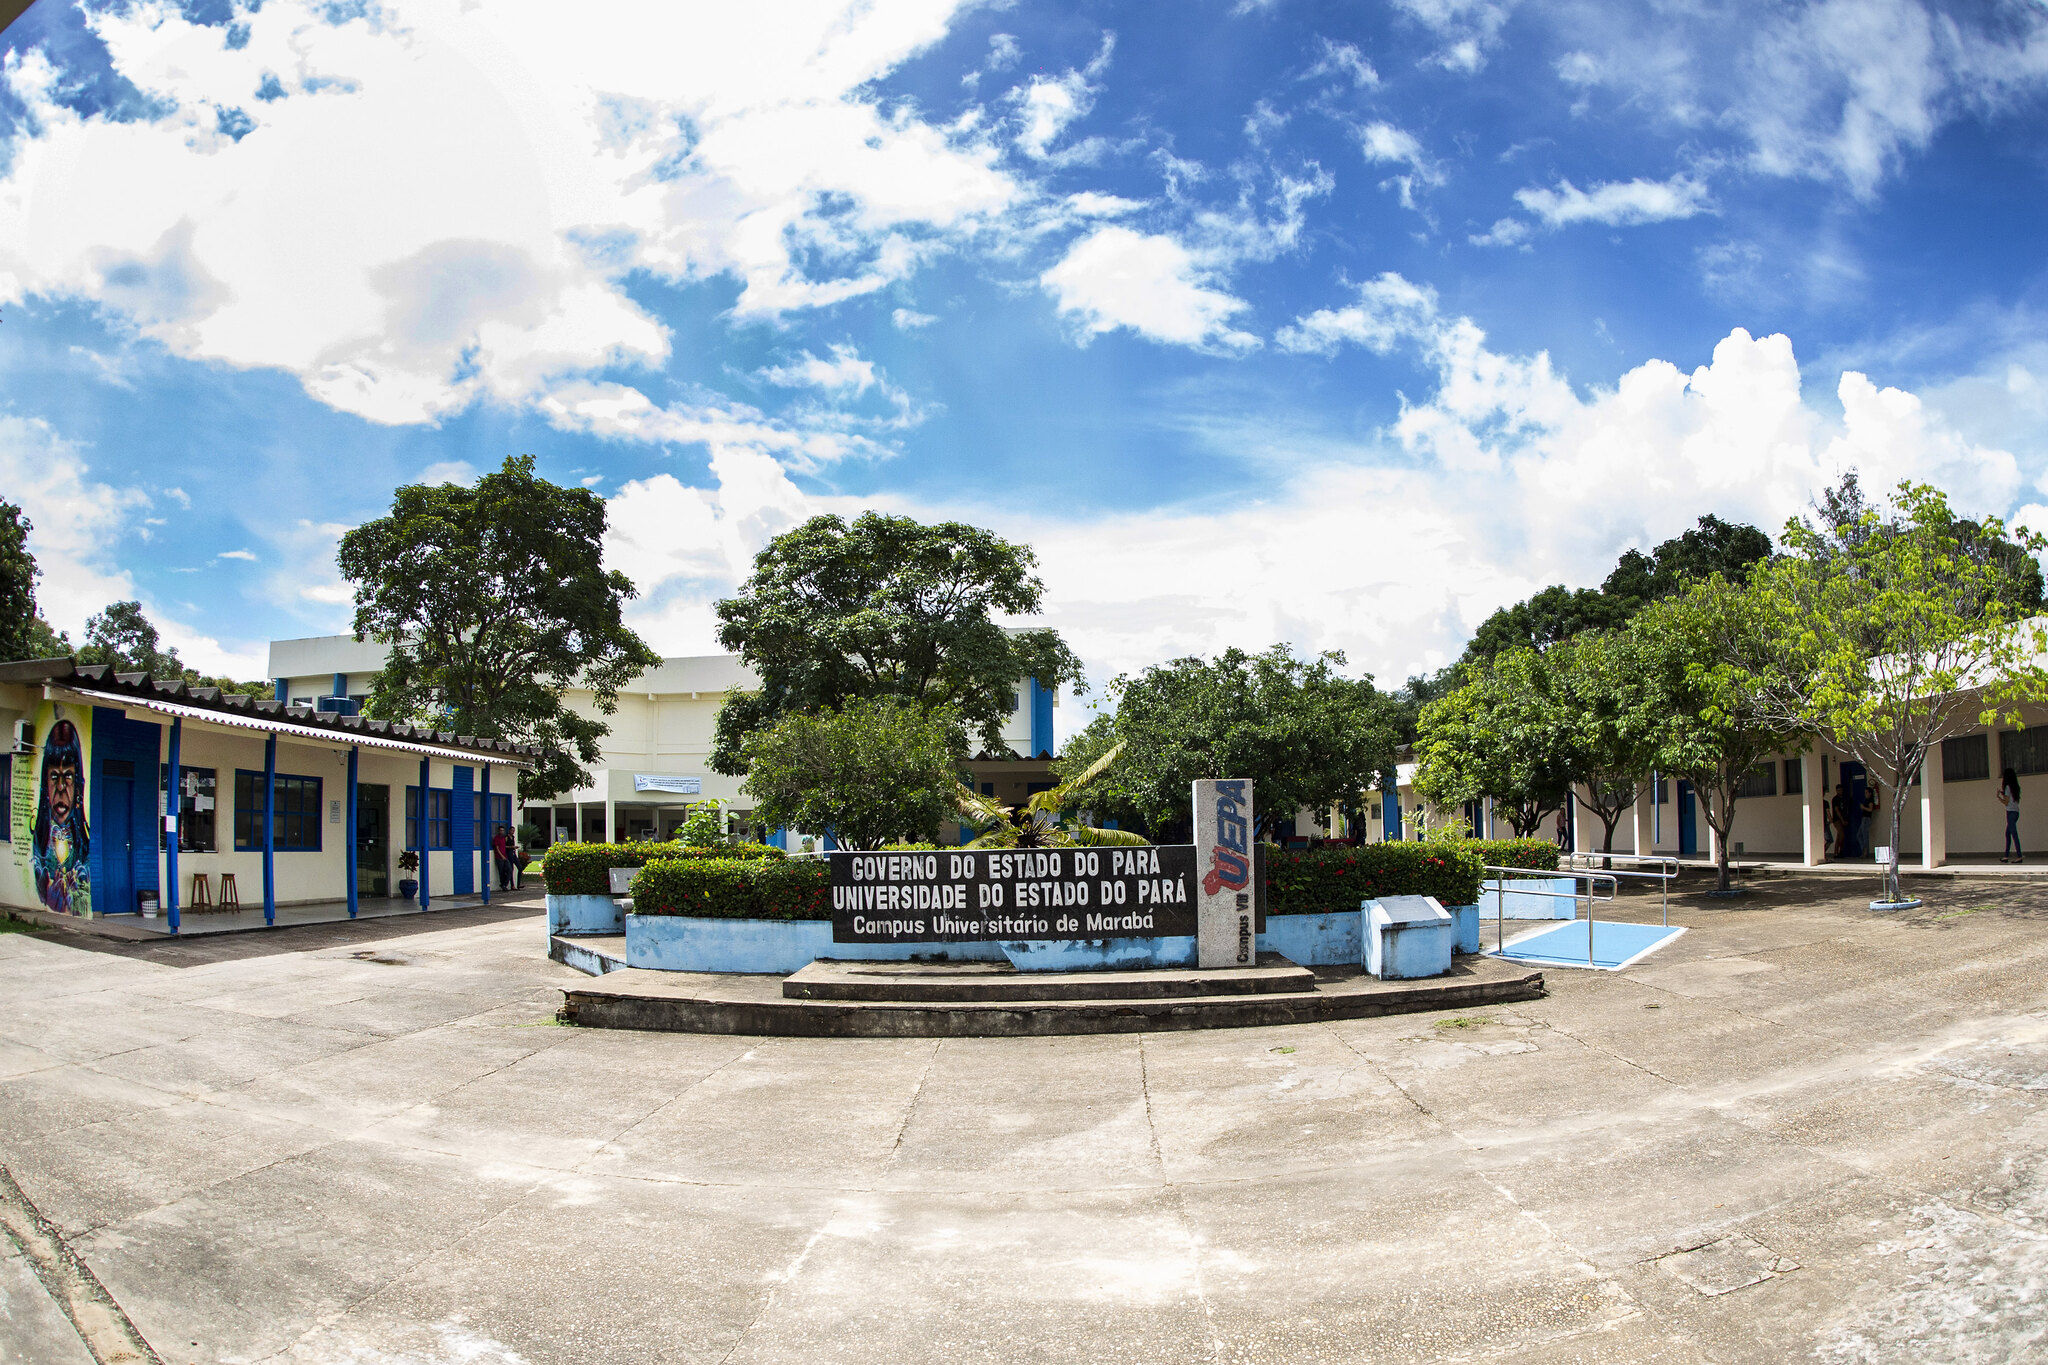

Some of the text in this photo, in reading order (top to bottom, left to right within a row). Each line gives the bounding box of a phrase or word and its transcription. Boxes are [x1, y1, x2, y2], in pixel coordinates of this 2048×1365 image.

[1216, 780, 1249, 885] UEPA
[852, 845, 1161, 881] GOVERNO DO ESTADO DO PARÁ
[833, 872, 1187, 910] UNIVERSIDADE DO ESTADO DO PARÁ
[853, 908, 1154, 938] Campus Universitário de Marabá
